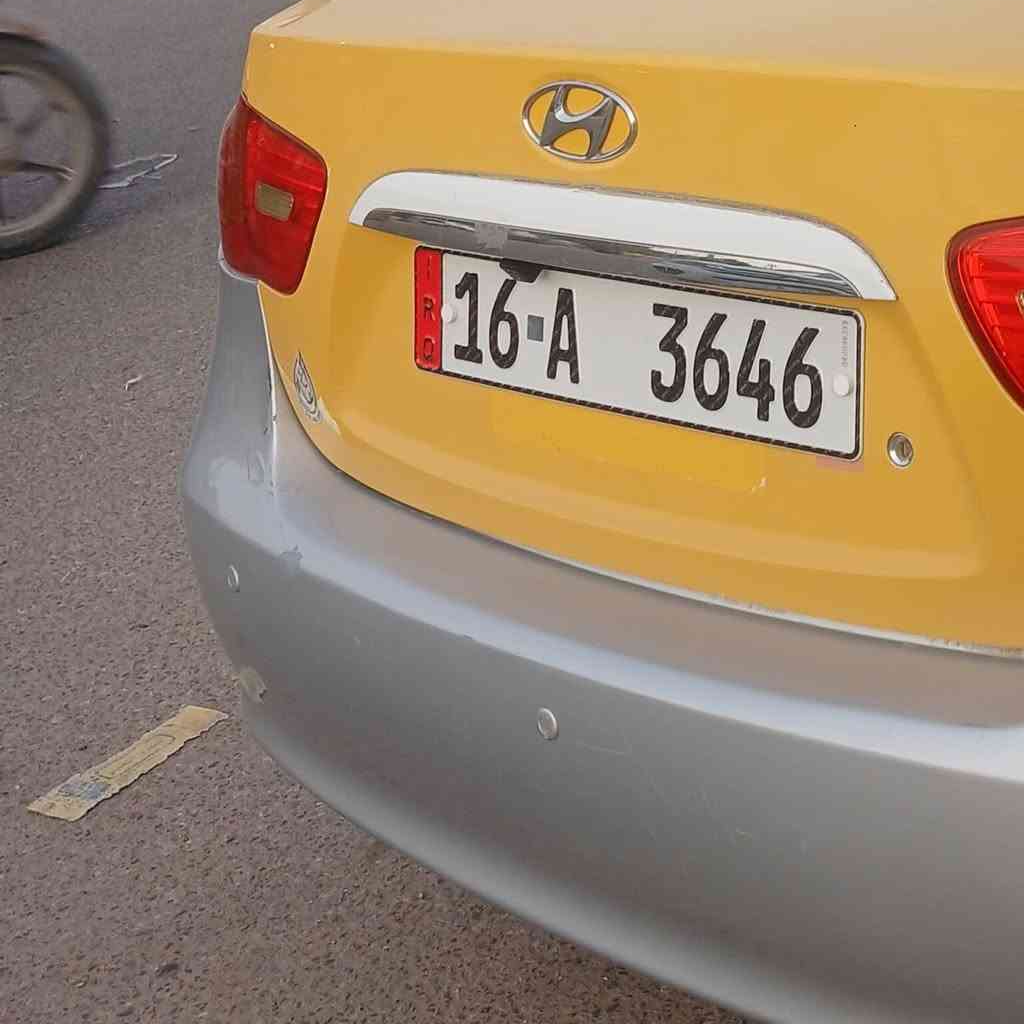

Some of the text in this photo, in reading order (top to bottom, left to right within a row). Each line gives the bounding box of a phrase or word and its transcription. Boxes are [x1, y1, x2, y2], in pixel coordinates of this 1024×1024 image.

[454, 271, 520, 369] 16
[546, 287, 580, 384] A
[651, 302, 823, 429] 3646
